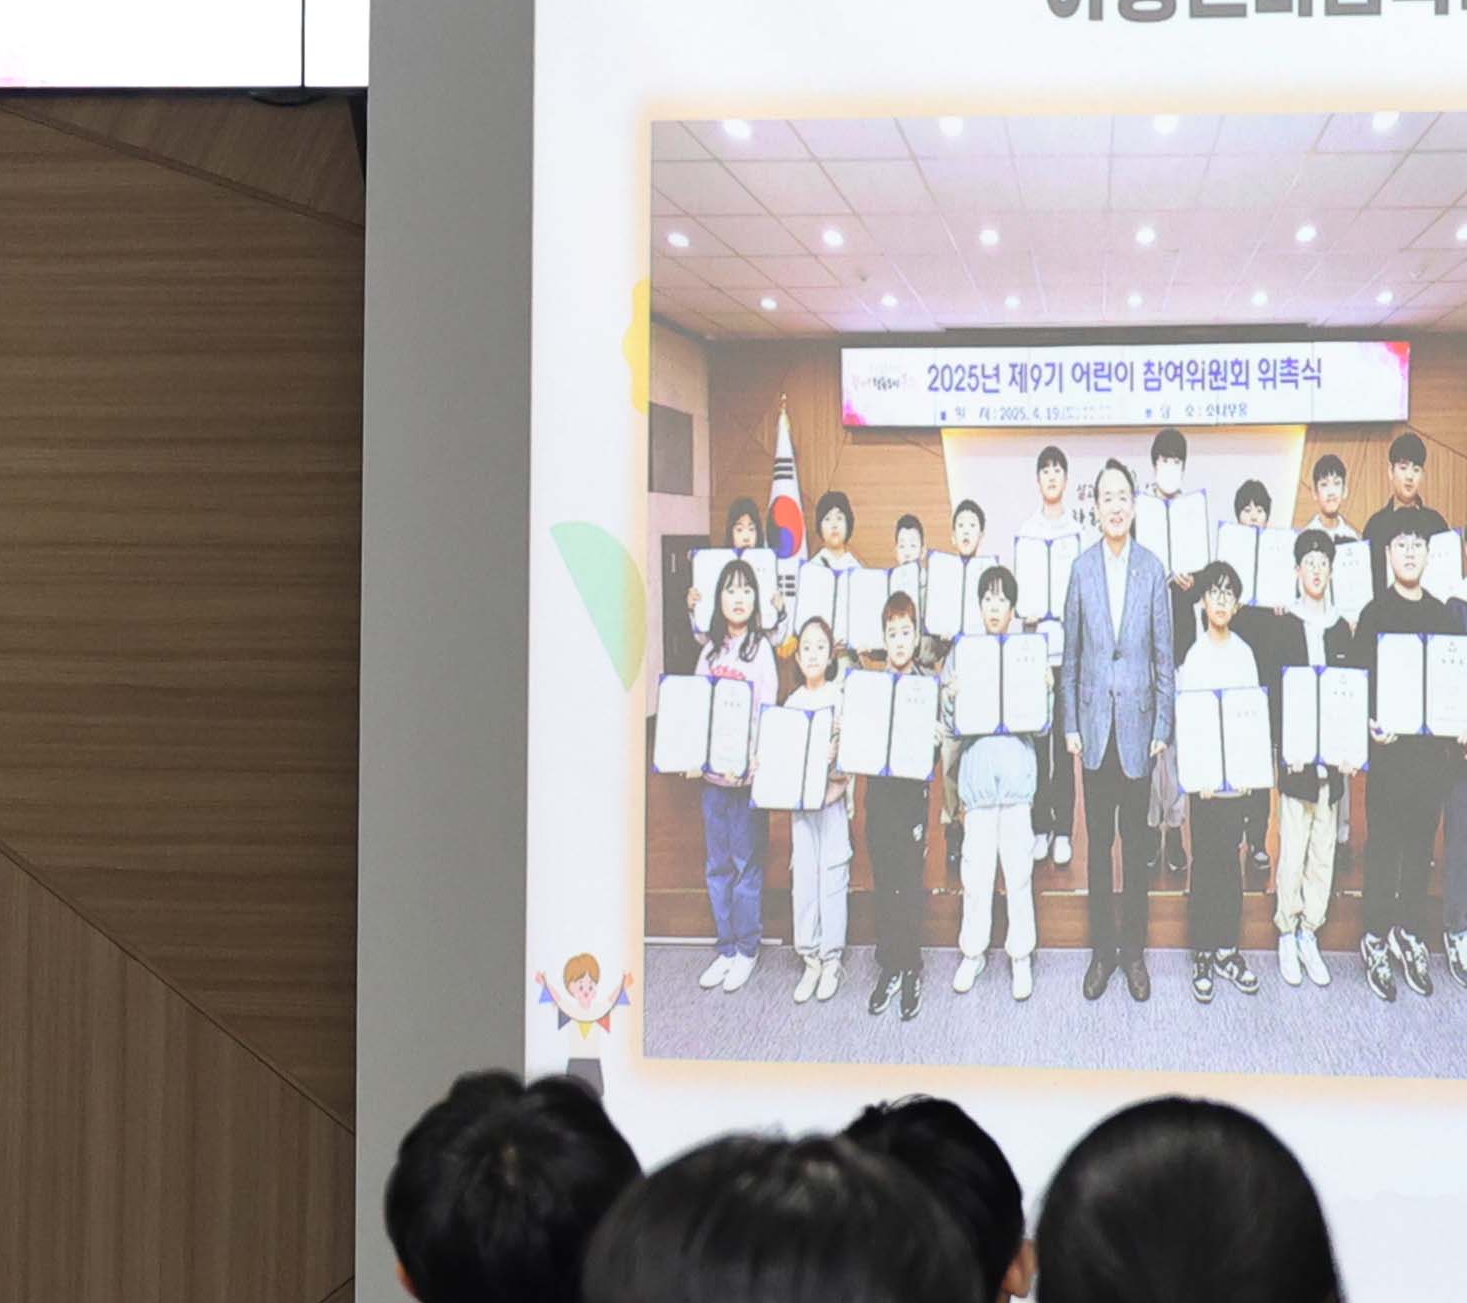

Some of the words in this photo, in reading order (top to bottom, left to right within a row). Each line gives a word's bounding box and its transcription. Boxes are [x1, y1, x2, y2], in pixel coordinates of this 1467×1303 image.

[927, 363, 1001, 395] 2025년
[1008, 361, 1064, 394] 제9기
[1070, 360, 1135, 393] 어린이
[1143, 357, 1250, 393] 참여위원회
[1257, 356, 1322, 391] 위촉식
